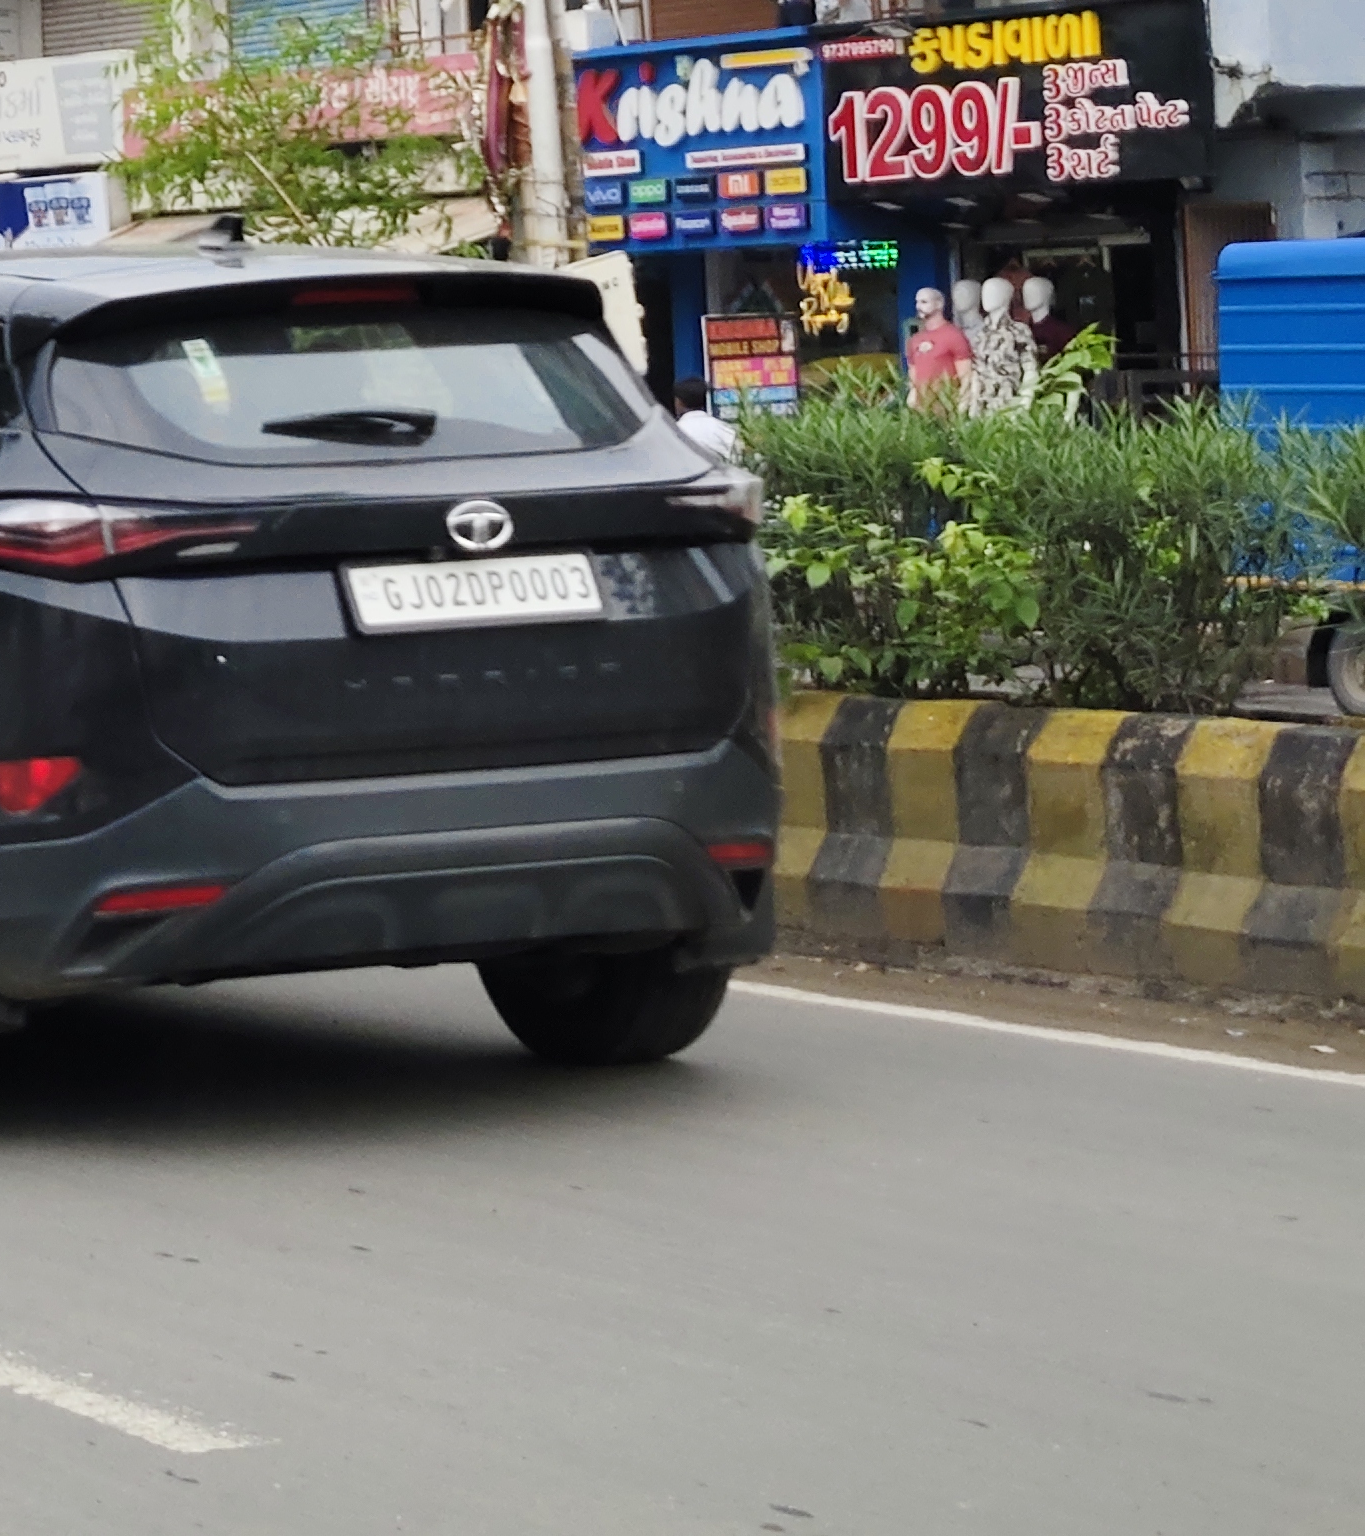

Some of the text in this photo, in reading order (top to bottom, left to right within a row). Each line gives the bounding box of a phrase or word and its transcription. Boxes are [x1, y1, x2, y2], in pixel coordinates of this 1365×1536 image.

[908, 10, 1102, 74] કપડાવાળા
[578, 57, 806, 148] Krishna
[828, 76, 1043, 183] 1299/-
[586, 186, 619, 203] vivo
[631, 183, 664, 199] oppo
[383, 566, 590, 611] GJ02DP0003
